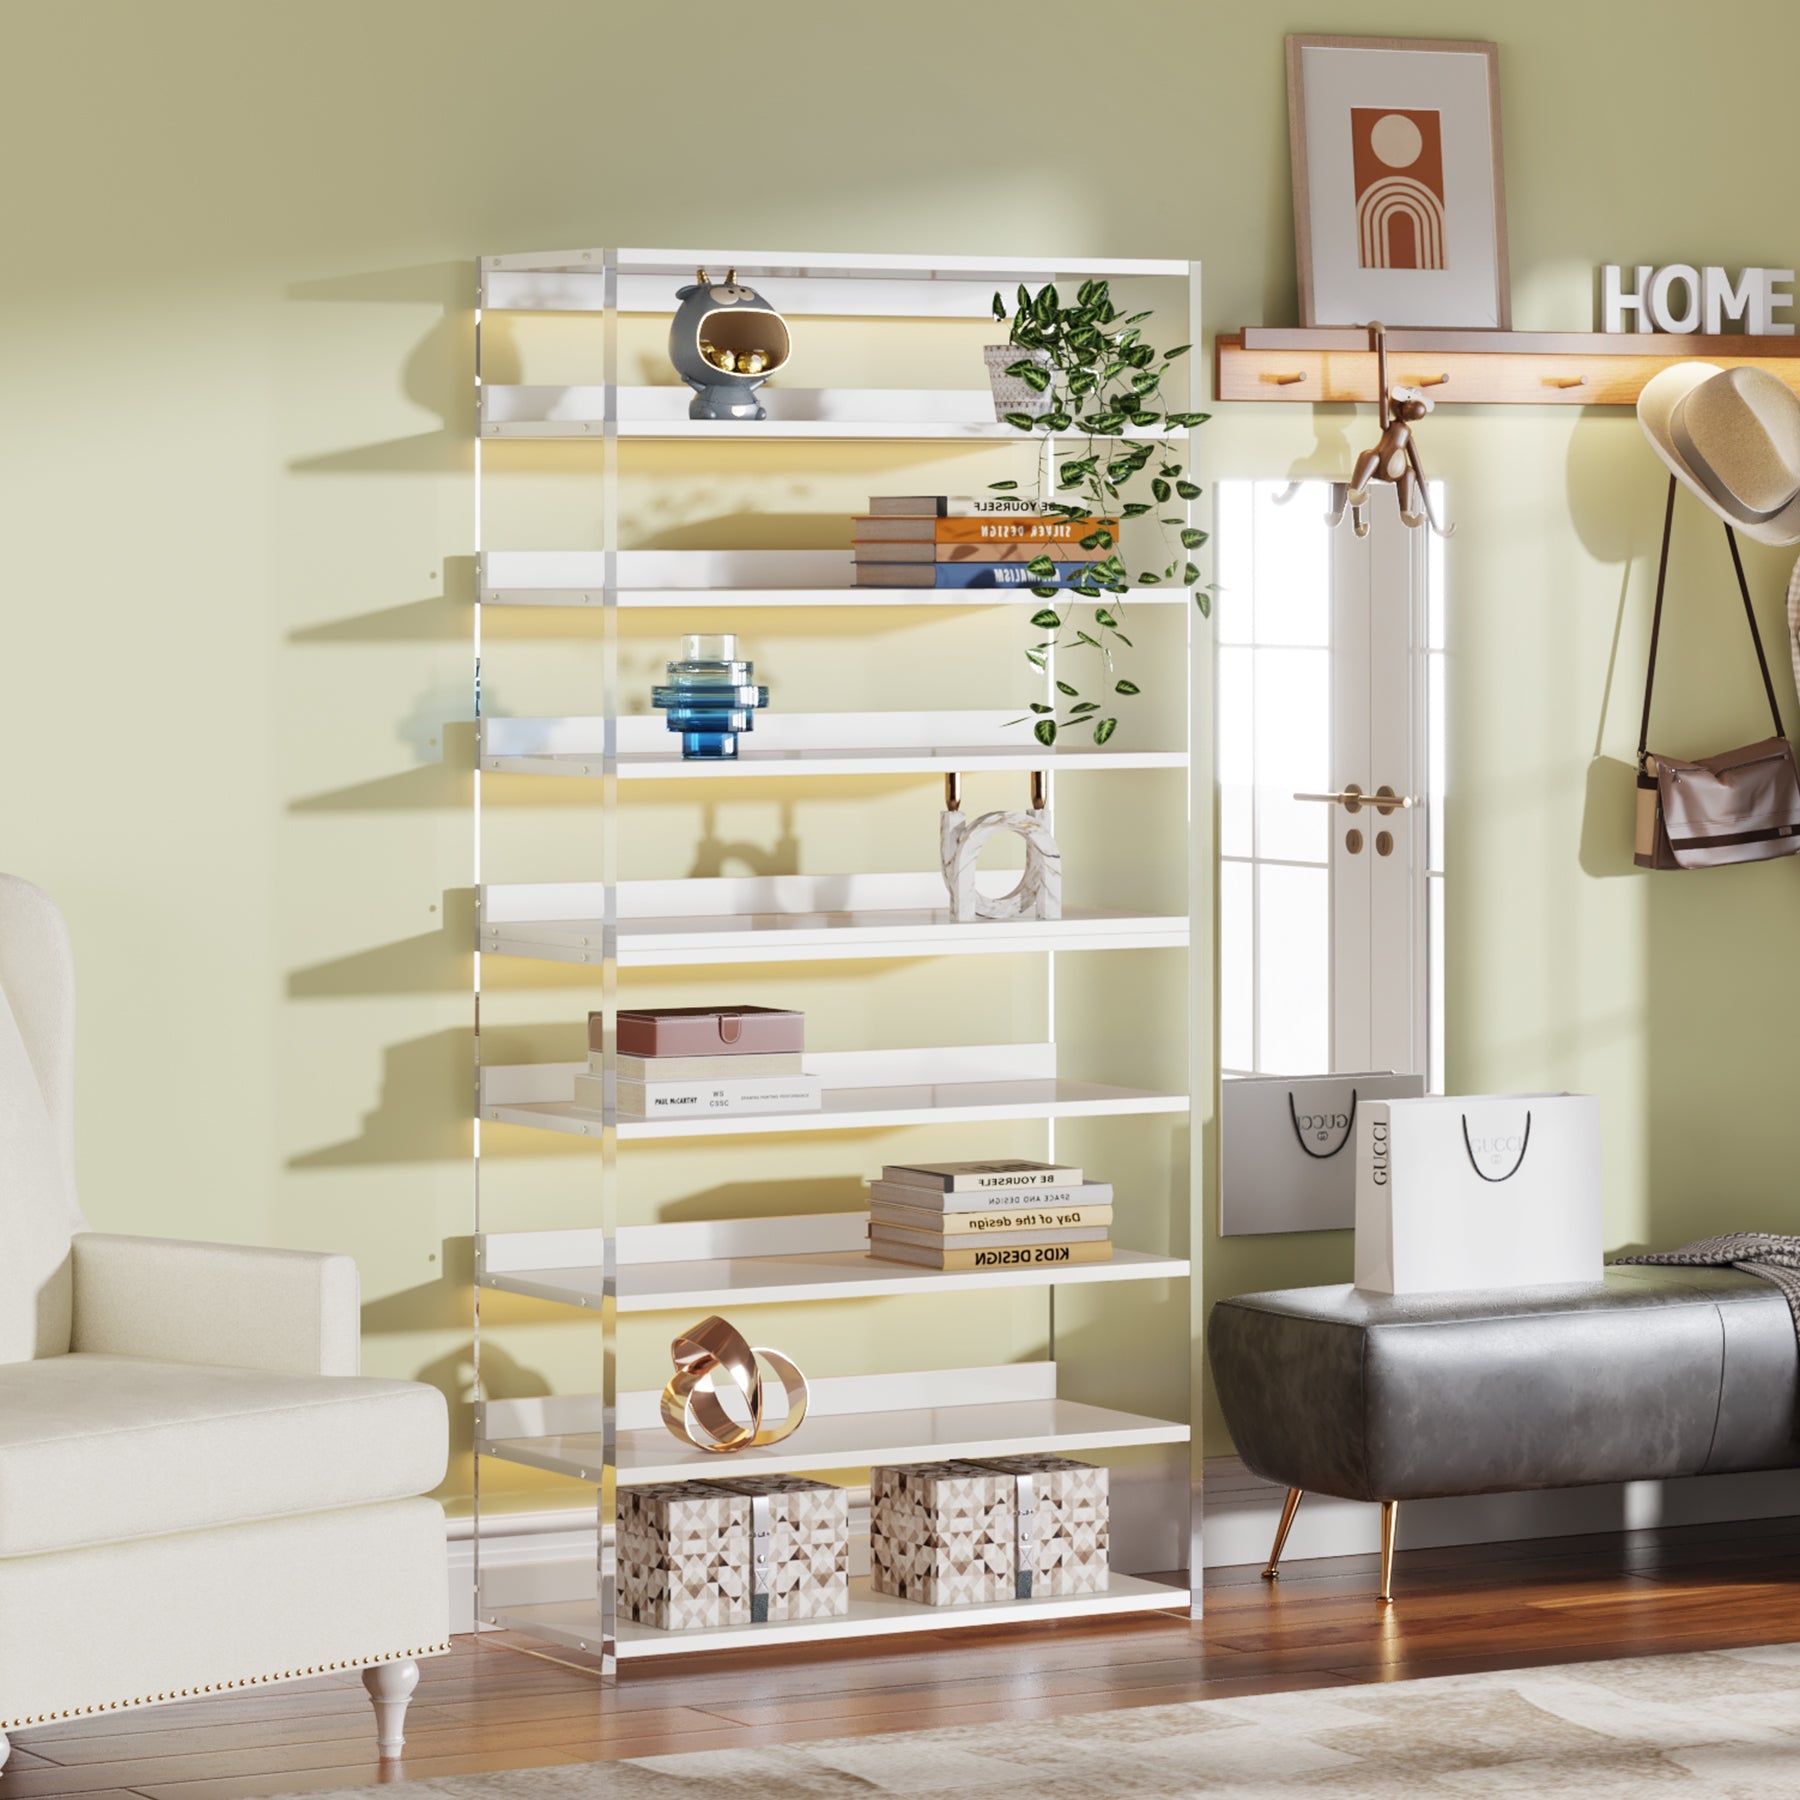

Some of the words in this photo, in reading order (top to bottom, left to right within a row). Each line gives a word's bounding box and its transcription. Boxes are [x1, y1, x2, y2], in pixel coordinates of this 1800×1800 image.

[1601, 263, 1796, 335] HOME
[655, 1098, 668, 1106] PAUL
[1373, 1121, 1387, 1186] GUCCI
[1470, 1136, 1524, 1153] GUCCI
